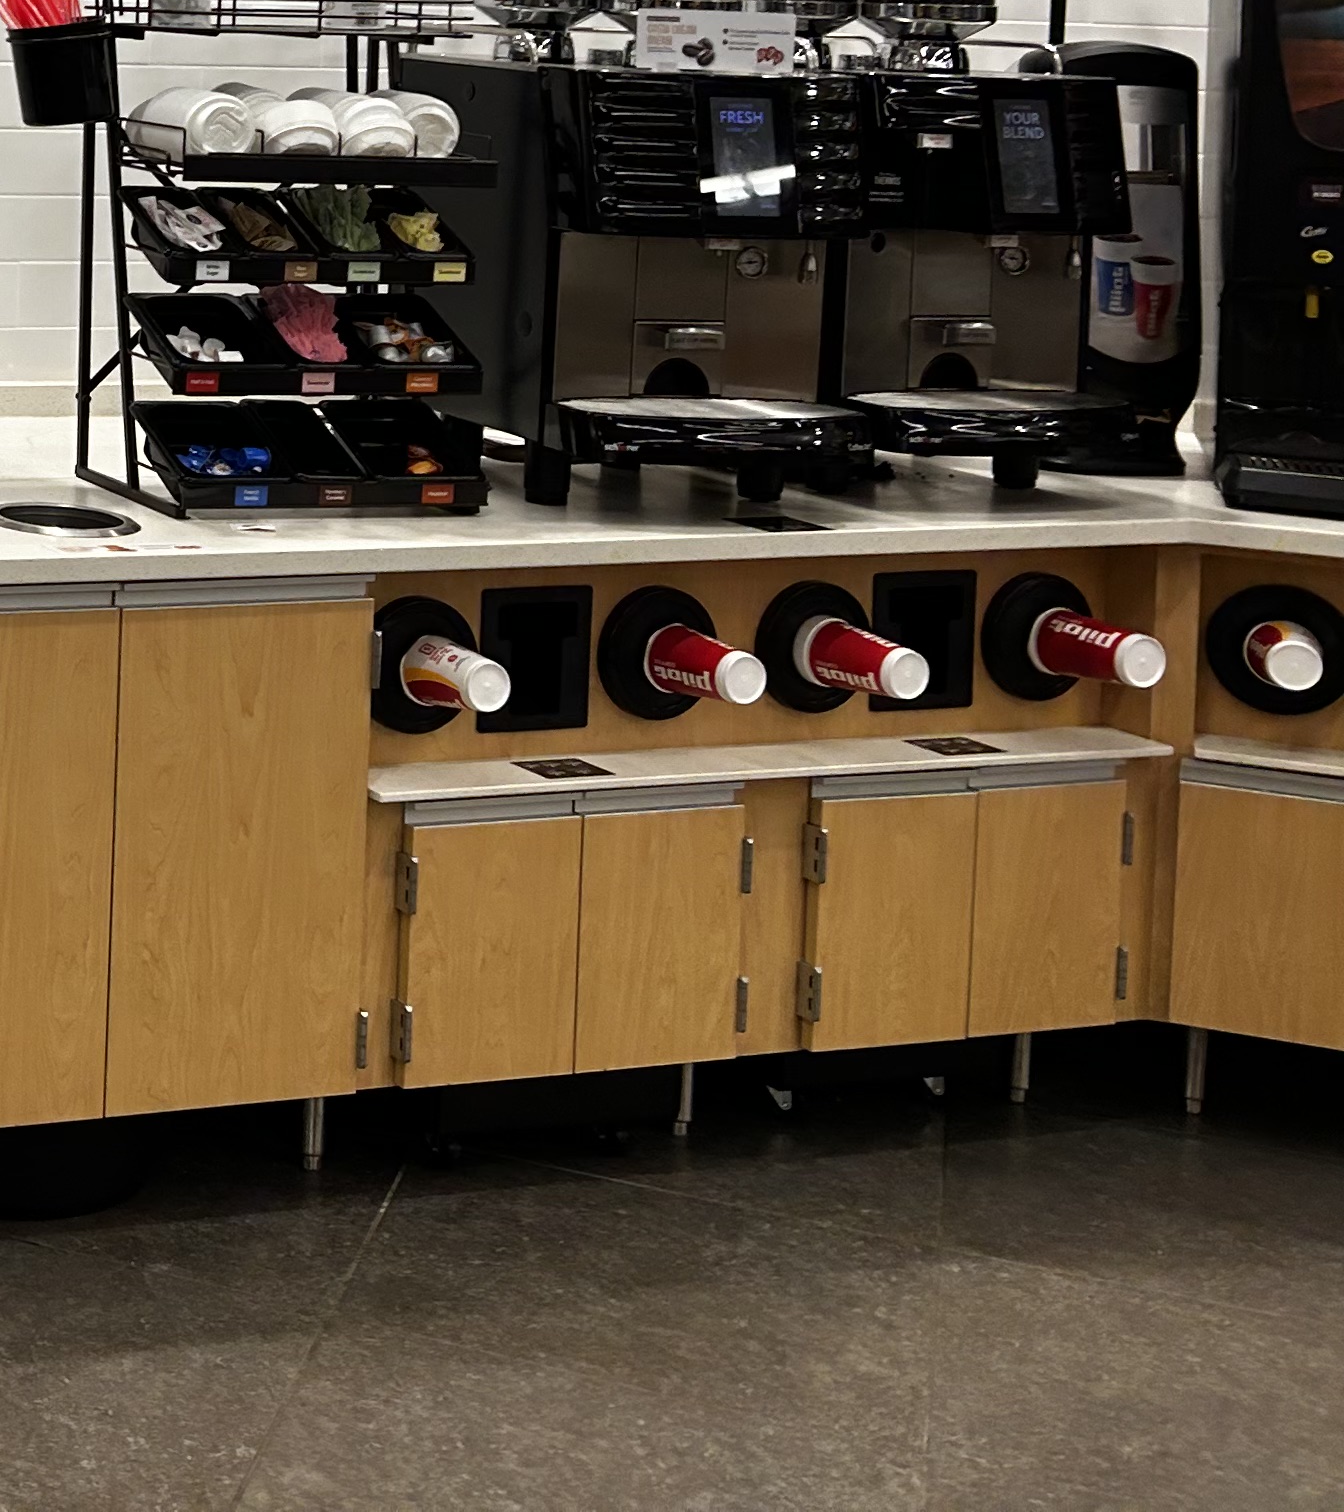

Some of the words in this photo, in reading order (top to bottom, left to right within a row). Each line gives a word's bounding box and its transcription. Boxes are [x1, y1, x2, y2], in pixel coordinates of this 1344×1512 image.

[719, 110, 764, 124] FRESH
[1003, 112, 1040, 125] YOUR
[1003, 126, 1045, 139] BLEND
[1109, 267, 1126, 312] pilot
[1049, 618, 1122, 649] pilot
[654, 665, 712, 691] pilot
[815, 665, 875, 692] pilot
